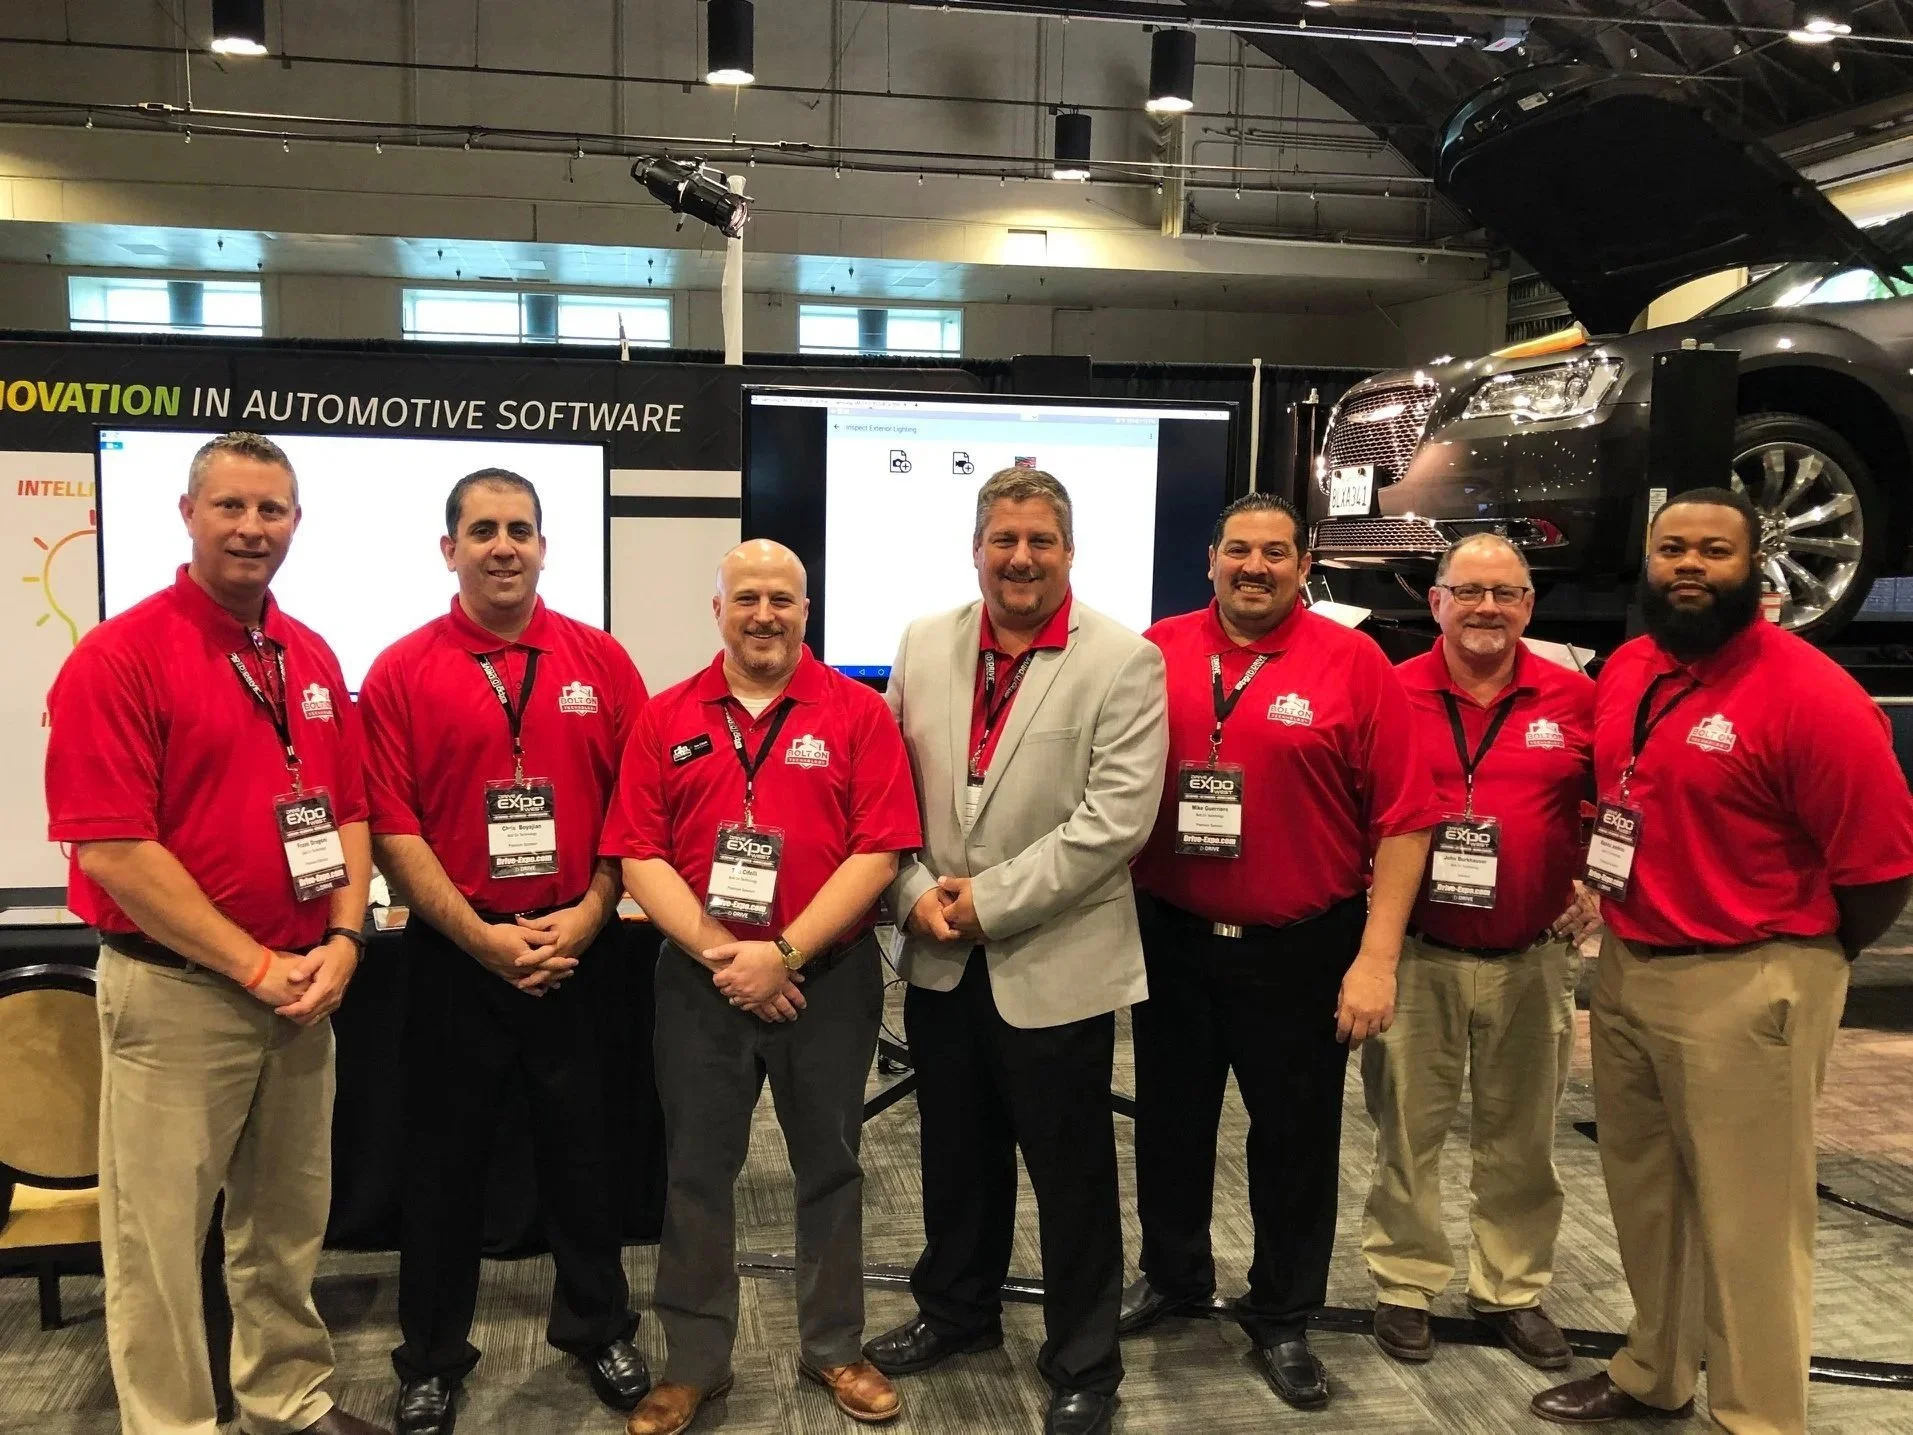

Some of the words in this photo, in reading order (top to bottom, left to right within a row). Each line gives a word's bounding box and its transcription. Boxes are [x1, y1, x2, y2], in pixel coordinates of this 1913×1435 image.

[0, 380, 181, 416] OVATION
[192, 387, 231, 417] IN
[242, 389, 486, 429] AUTOMOTIVE
[496, 400, 684, 433] SOFTWARE
[869, 424, 892, 432] Exterior
[893, 426, 917, 434] Lighting
[1271, 705, 1296, 715] BOLT
[1297, 710, 1312, 718] ON
